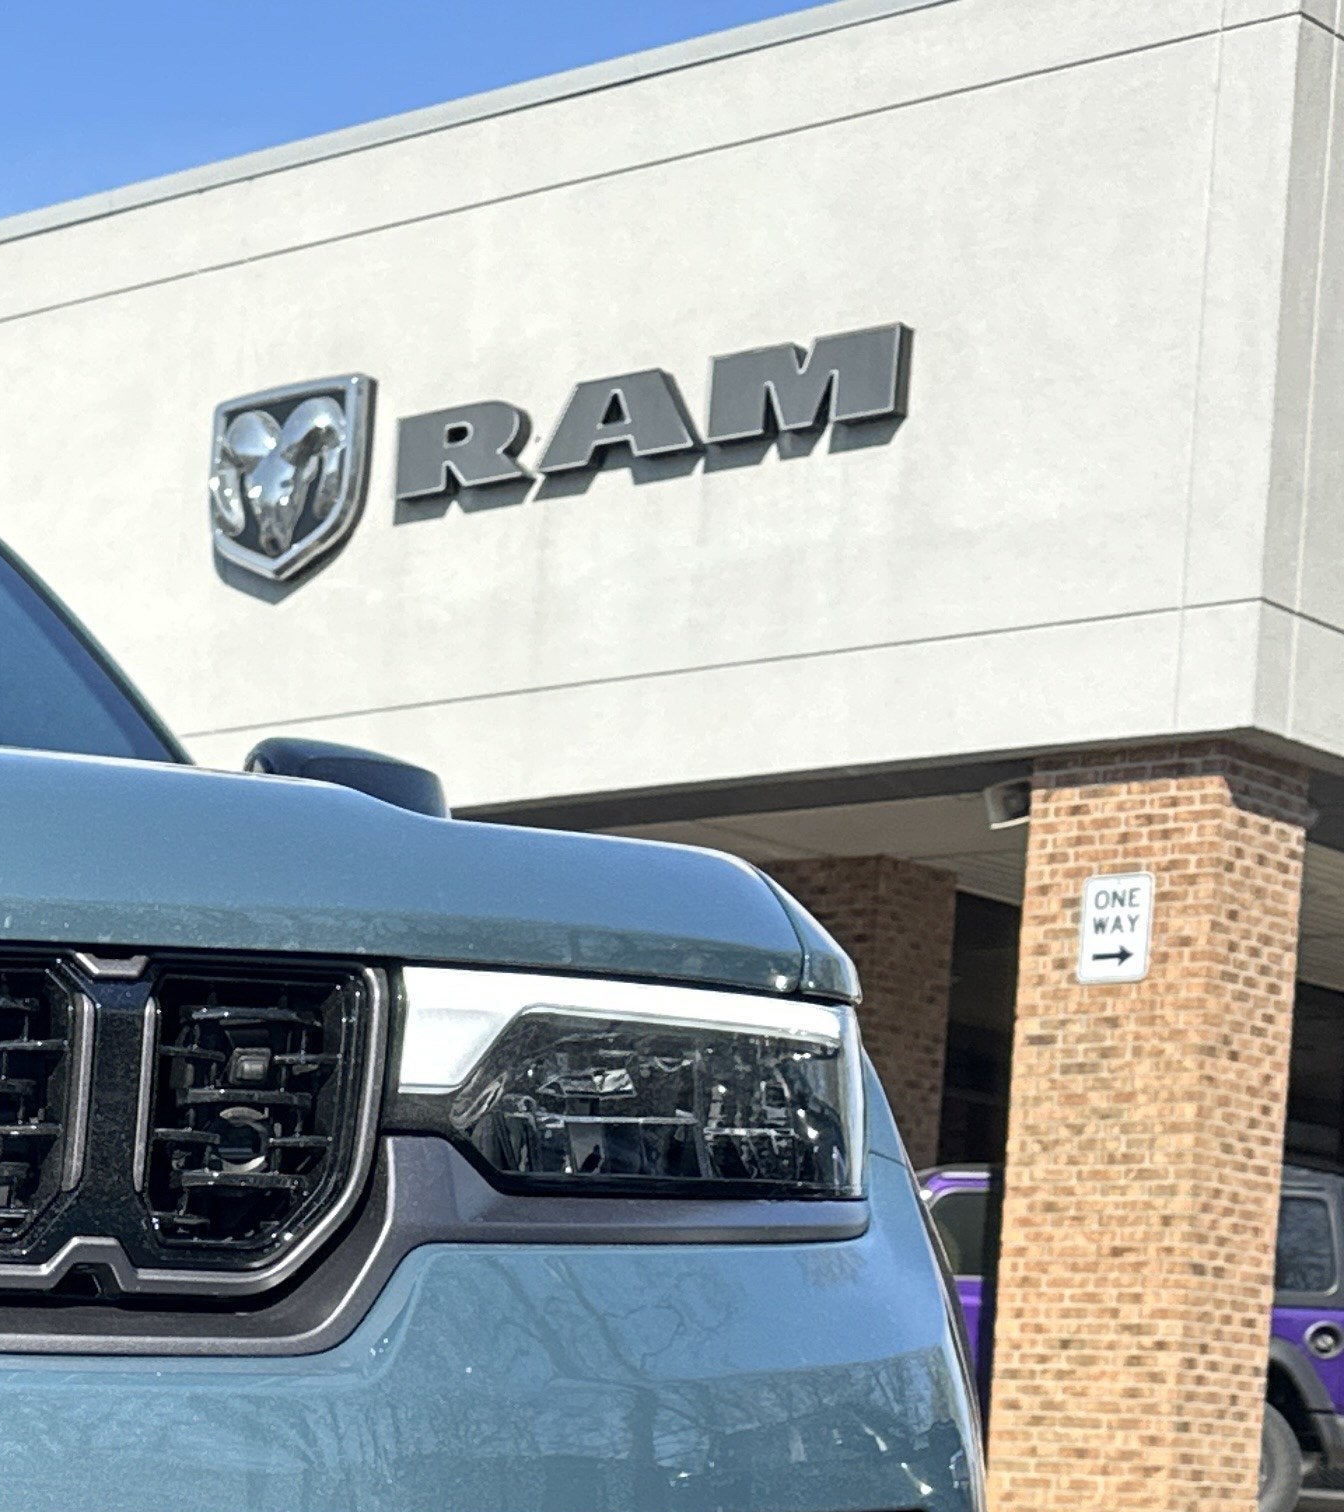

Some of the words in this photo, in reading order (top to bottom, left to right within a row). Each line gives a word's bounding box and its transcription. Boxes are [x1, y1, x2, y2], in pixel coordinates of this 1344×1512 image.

[394, 322, 914, 503] RAM
[1094, 887, 1141, 910] ONE
[1092, 914, 1140, 936] WAY
